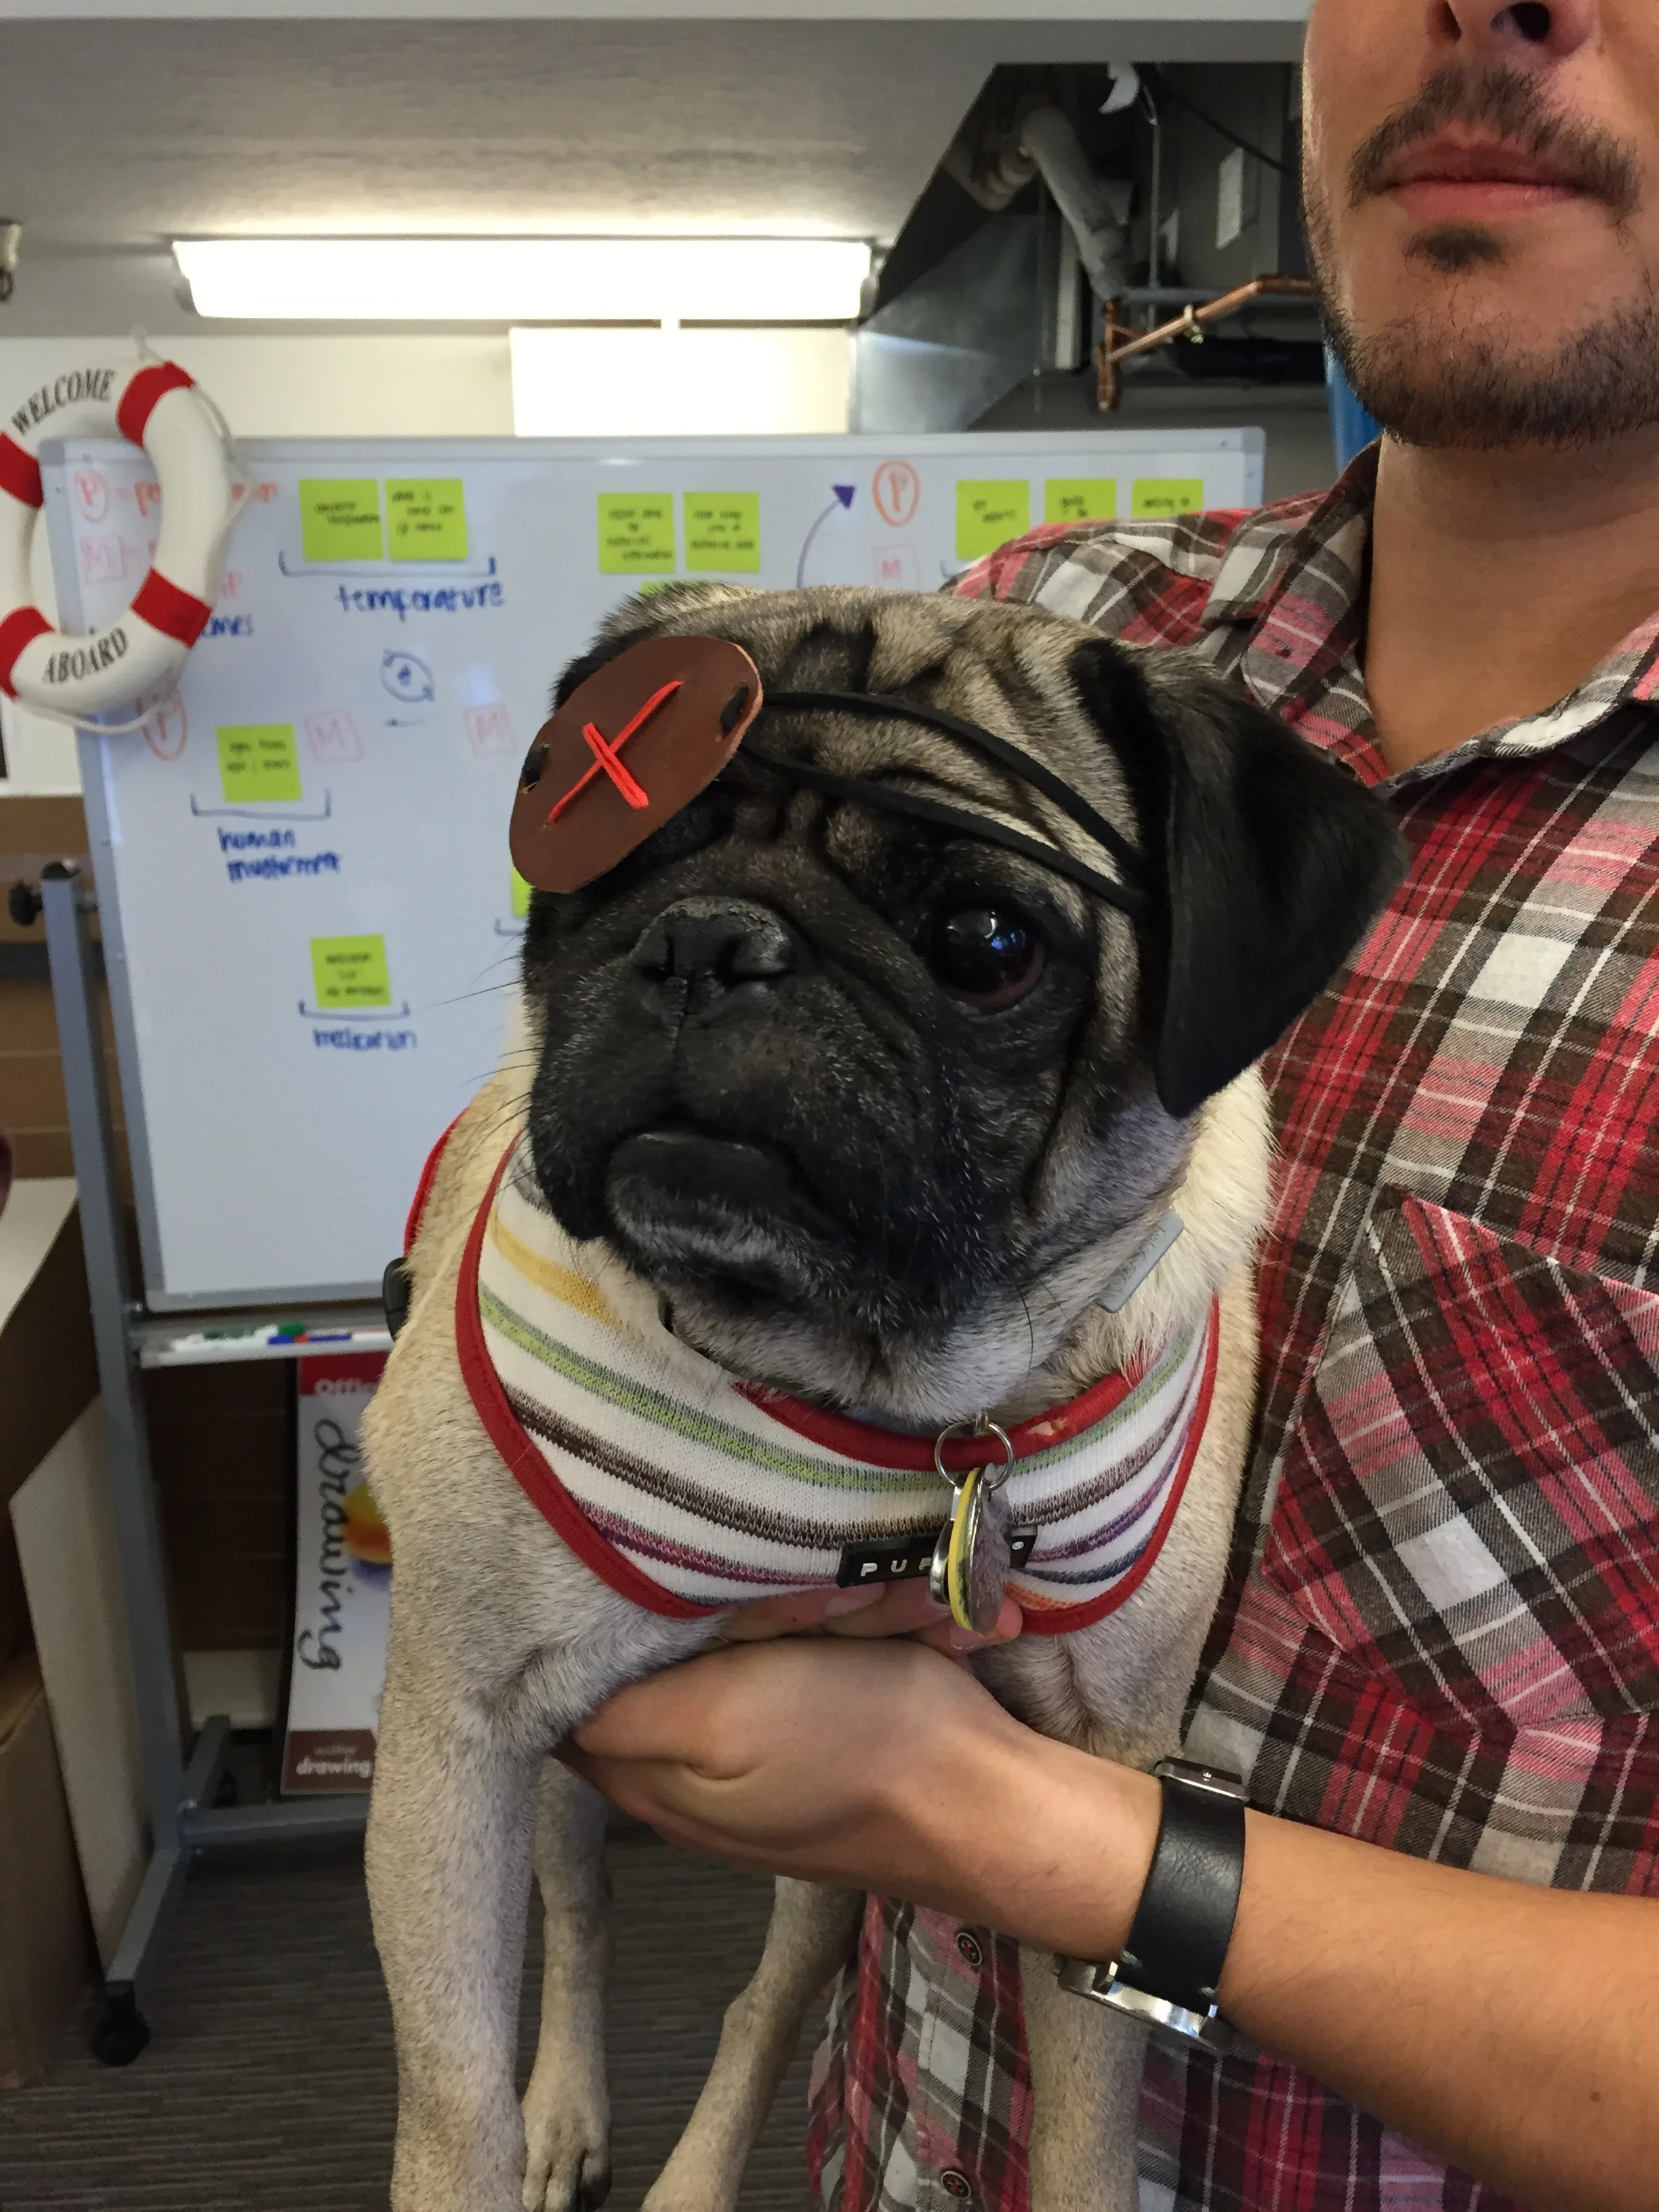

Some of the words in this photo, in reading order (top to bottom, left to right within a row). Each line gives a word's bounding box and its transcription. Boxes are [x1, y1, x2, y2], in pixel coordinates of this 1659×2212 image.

[12, 368, 115, 436] WELCOME
[43, 628, 127, 683] ABOARD
[295, 1757, 371, 1778] drawing
